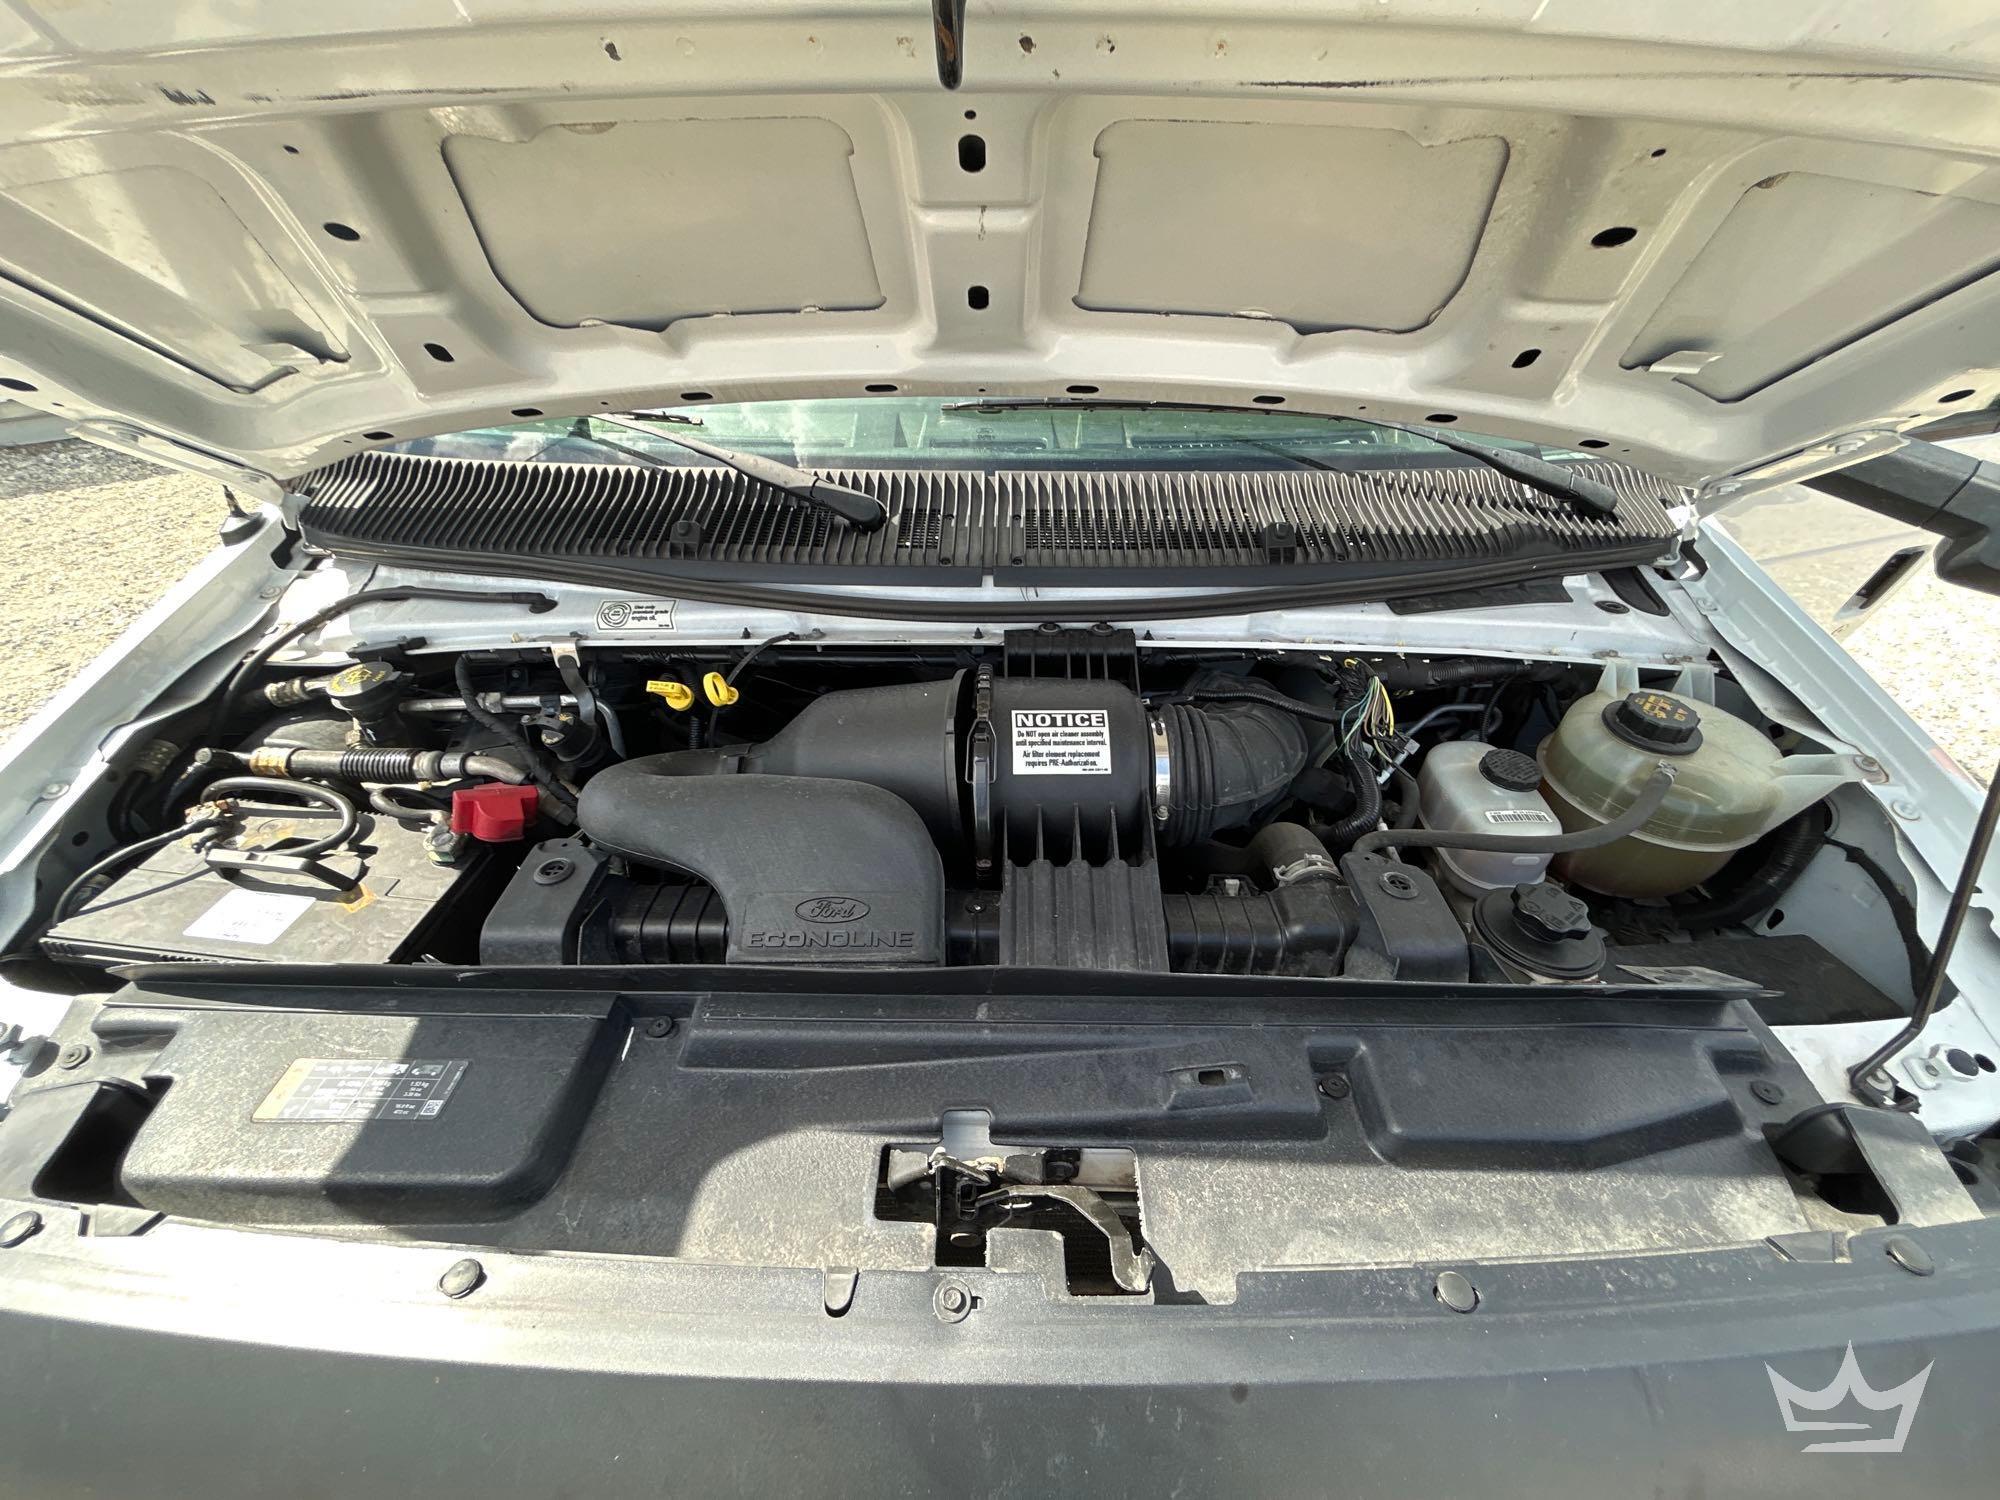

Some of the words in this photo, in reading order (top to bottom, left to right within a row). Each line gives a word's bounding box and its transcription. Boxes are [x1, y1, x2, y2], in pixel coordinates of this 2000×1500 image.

[1016, 713, 1105, 727] NOTICE
[1017, 730, 1025, 738] Do
[1025, 730, 1037, 738] NOT
[1038, 731, 1051, 740] open
[1051, 730, 1060, 738] air
[1060, 730, 1080, 738] cleaner
[1080, 730, 1104, 739] assembly
[1015, 739, 1027, 747] until
[1028, 739, 1052, 748] specified
[1052, 738, 1086, 746] maintenance
[1086, 738, 1107, 746] interval.
[1022, 750, 1031, 758] Air
[1032, 750, 1044, 758] filter
[1045, 750, 1067, 758] element
[1067, 750, 1100, 759] replacement
[1025, 759, 1048, 769] requires
[1048, 759, 1098, 767] PRE-Authorization.
[808, 899, 856, 919] Ford
[748, 931, 915, 948] ECONOLINE
